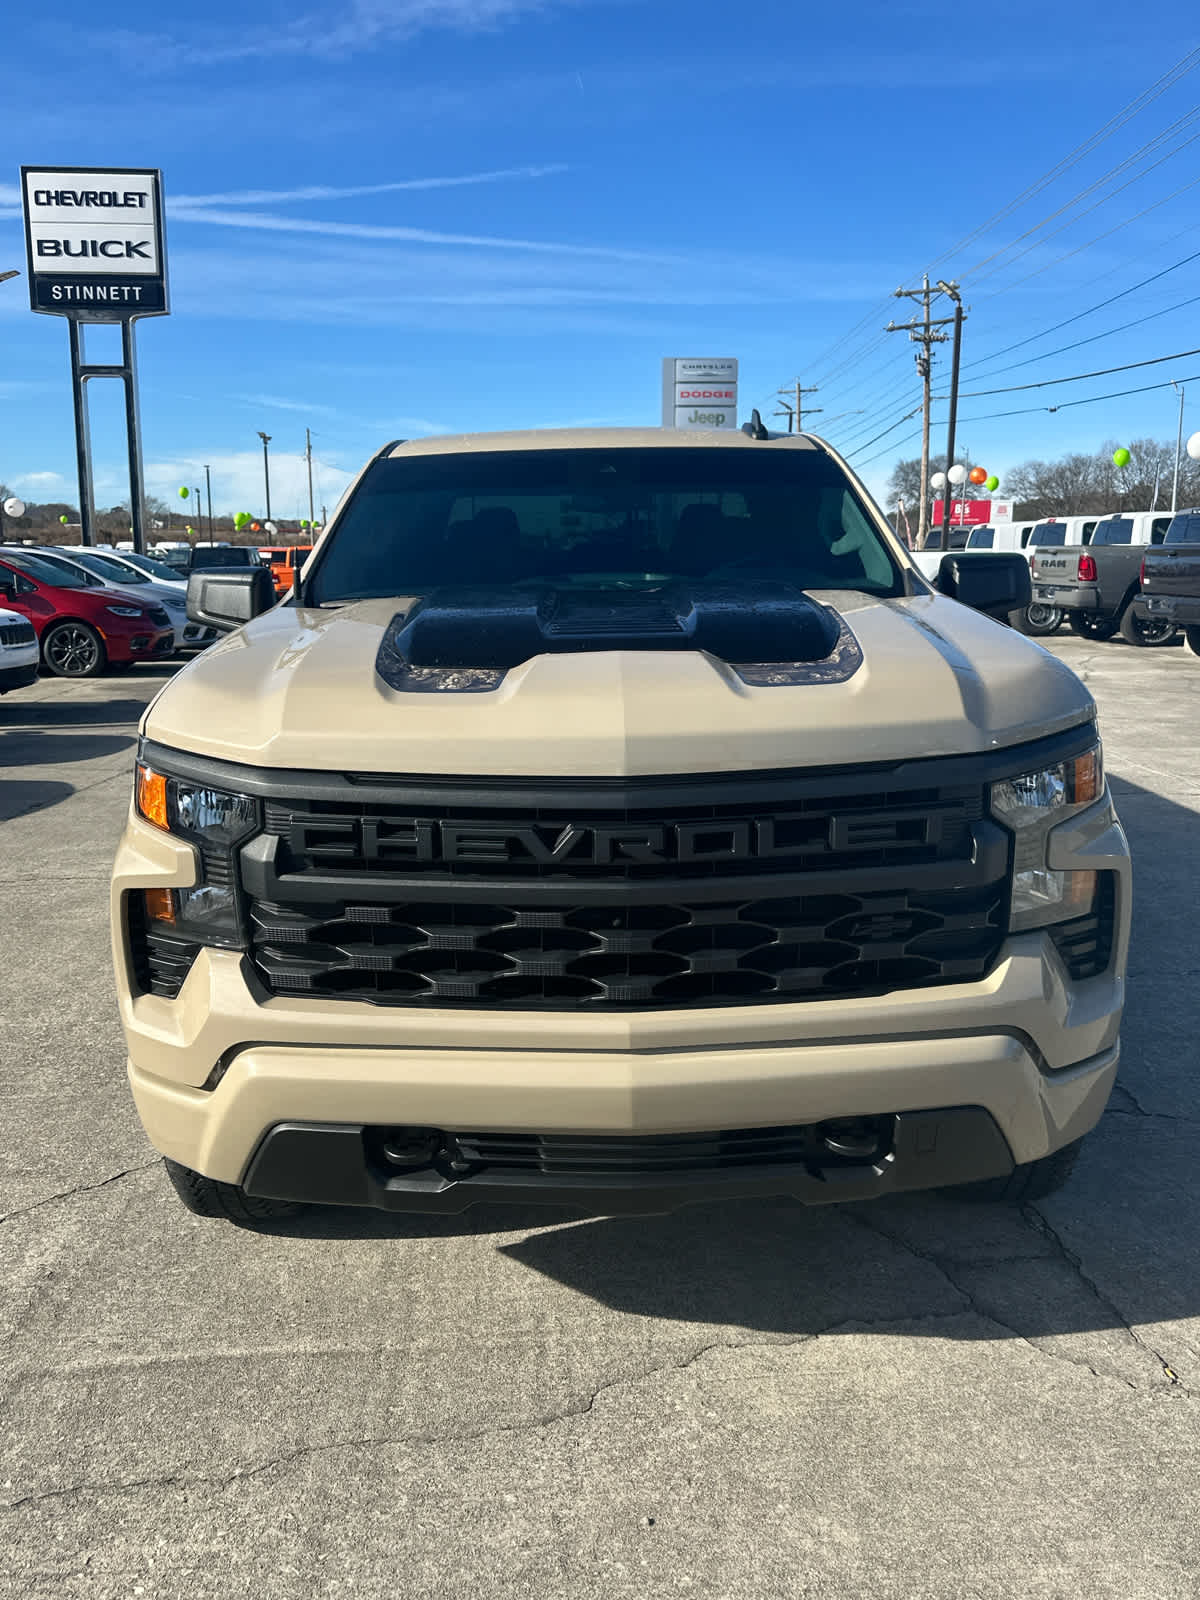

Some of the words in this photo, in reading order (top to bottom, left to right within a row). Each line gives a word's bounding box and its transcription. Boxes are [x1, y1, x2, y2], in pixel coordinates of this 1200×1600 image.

[34, 190, 148, 208] CHEVROLET
[36, 239, 152, 259] BUICK
[51, 285, 142, 301] STINNETT
[680, 391, 734, 399] DODGE
[688, 409, 726, 427] Jeep
[1041, 559, 1067, 568] RAM
[288, 805, 956, 865] CHEVROLET
